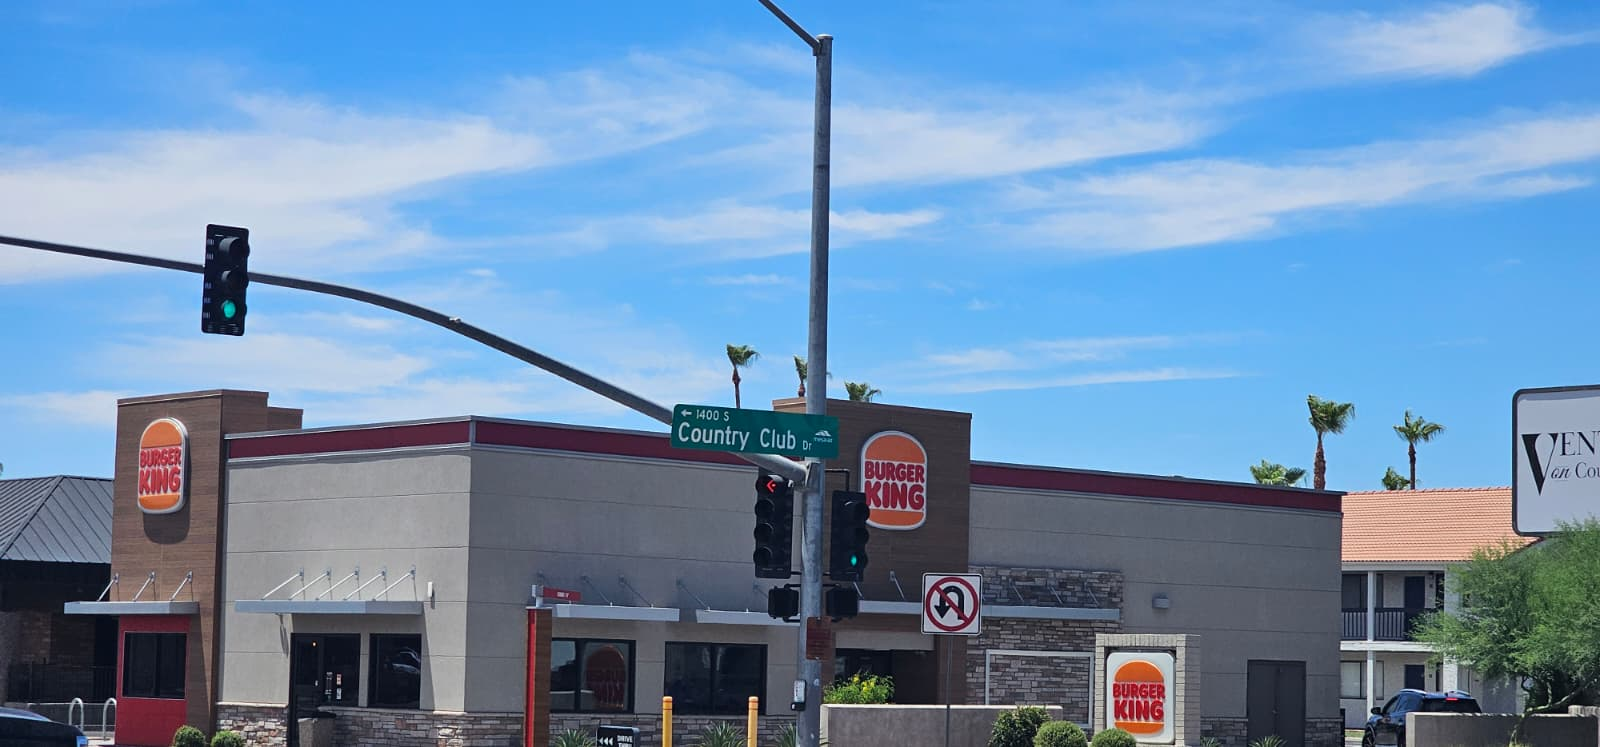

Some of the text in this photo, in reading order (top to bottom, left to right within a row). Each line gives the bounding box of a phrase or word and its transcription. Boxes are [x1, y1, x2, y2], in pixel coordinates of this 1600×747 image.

[696, 409, 730, 422] 1400 S
[678, 422, 812, 451] Country Club Dr
[140, 447, 182, 468] BURGER
[1521, 430, 1600, 496] VEN
[139, 466, 181, 495] KING
[864, 461, 925, 483] BURGER
[864, 480, 925, 510] KING
[1112, 683, 1166, 699] BURGER
[1113, 699, 1165, 721] KING
